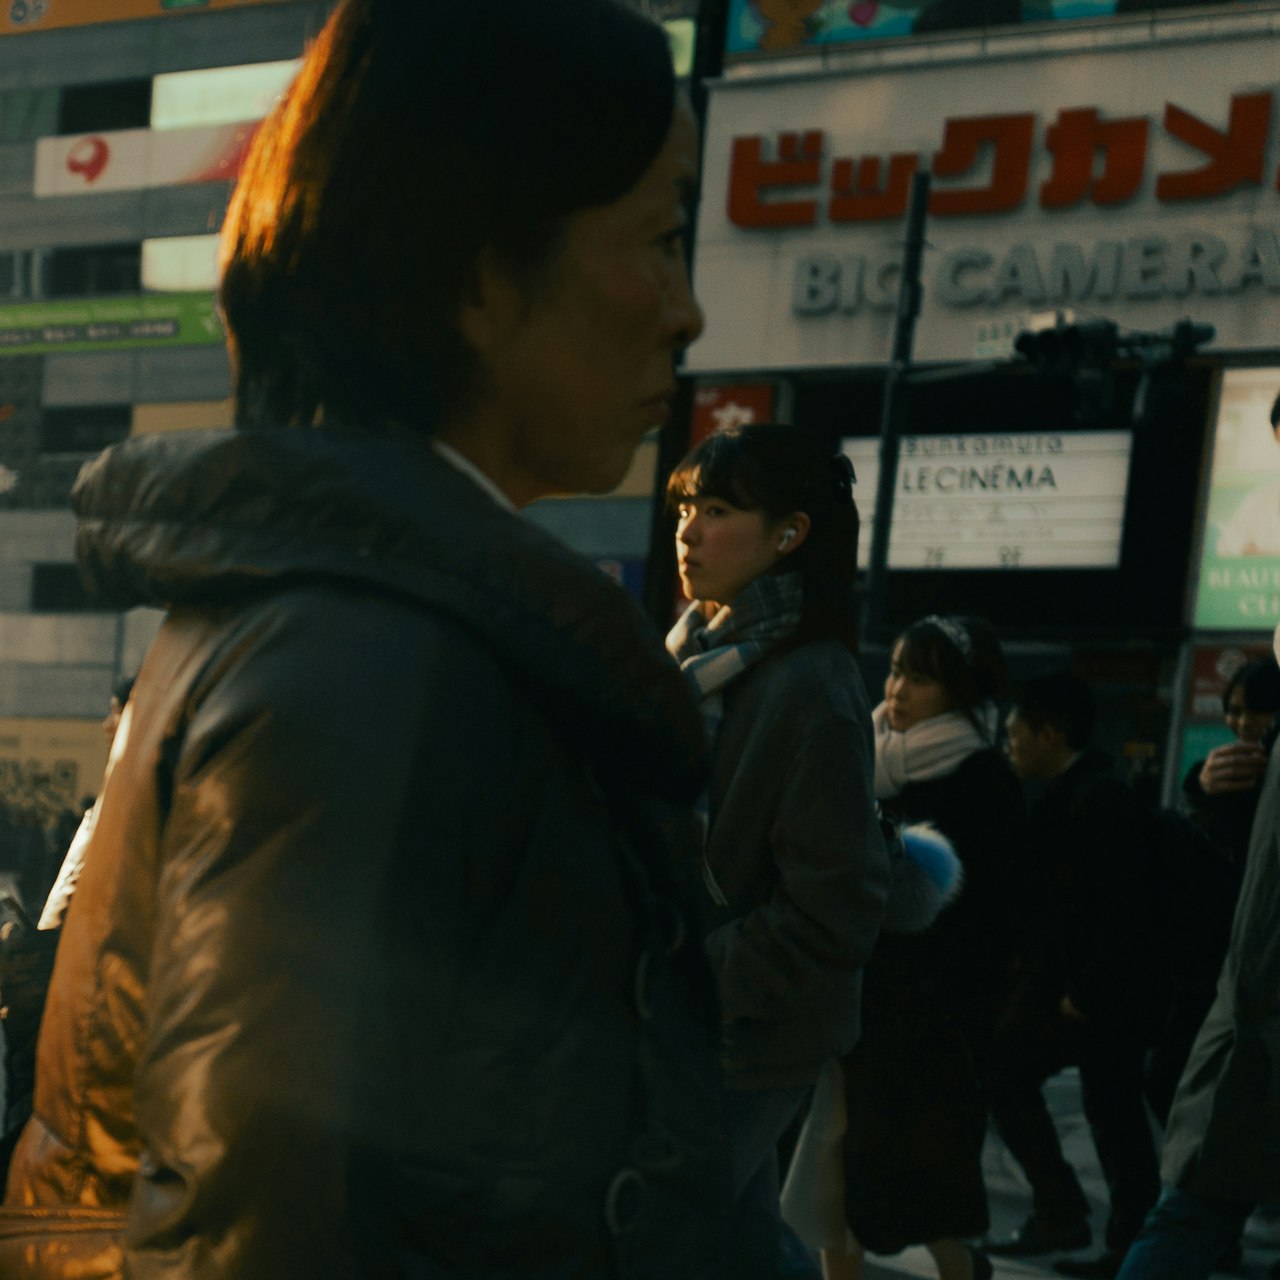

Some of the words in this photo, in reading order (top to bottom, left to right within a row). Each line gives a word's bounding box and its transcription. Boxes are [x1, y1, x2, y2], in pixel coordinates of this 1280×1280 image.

[727, 92, 1280, 228] ビックカメ
[940, 226, 1280, 309] CAMERA
